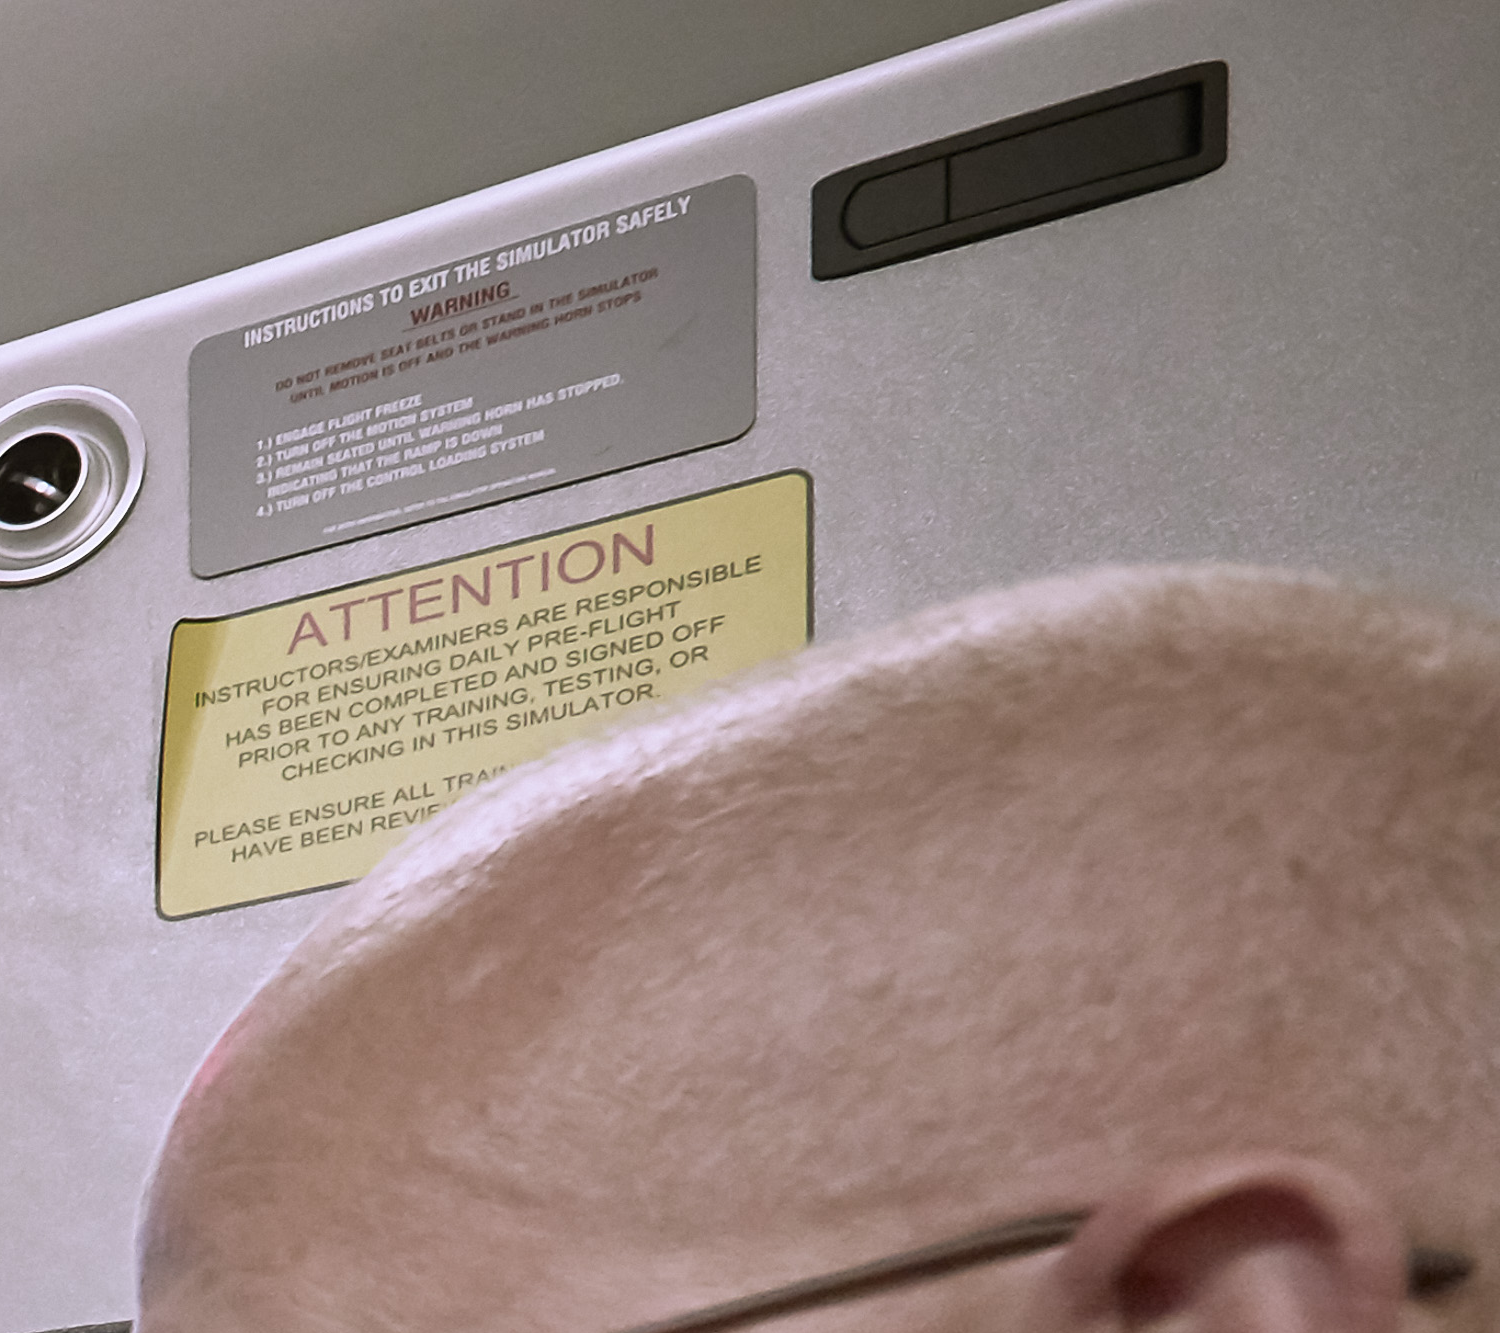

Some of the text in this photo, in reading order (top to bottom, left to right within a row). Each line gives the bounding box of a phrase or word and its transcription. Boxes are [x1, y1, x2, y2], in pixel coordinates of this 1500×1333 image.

[244, 196, 691, 348] INSTRUCTIONS TO EXIT THE SIMULATOR SAFELY
[275, 268, 659, 391] DO NOT REMOVE SEAT BELTS OR STAND IN THE SIMULATOR
[410, 282, 510, 325] WARNING
[256, 395, 422, 450] 1.) ENGAGE FLIGHT FREEZE
[256, 398, 473, 467] 2.) TURN OFF THE MOTION SYSTEM
[195, 555, 763, 709] INSTRUCTORS/EXAMINERS ARE RESPONSIBLE
[286, 524, 655, 655] ATTENTION
[225, 615, 727, 748] HAS BEEN COMPLETED AND SIGNED OFF
[238, 645, 710, 769] PRIOR TO ANY TRAINING, TESTING, OR
[262, 600, 682, 715] FOR ENSURING DAILY PRE-FLIGHT
[281, 682, 662, 783] CHECKING IN THIS SIMULATOR.
[194, 816, 282, 848] PLEASE
[289, 792, 385, 826] ENSURE
[393, 783, 436, 803] ALL
[231, 837, 293, 863] HAVE
[300, 824, 364, 848] BEEN
